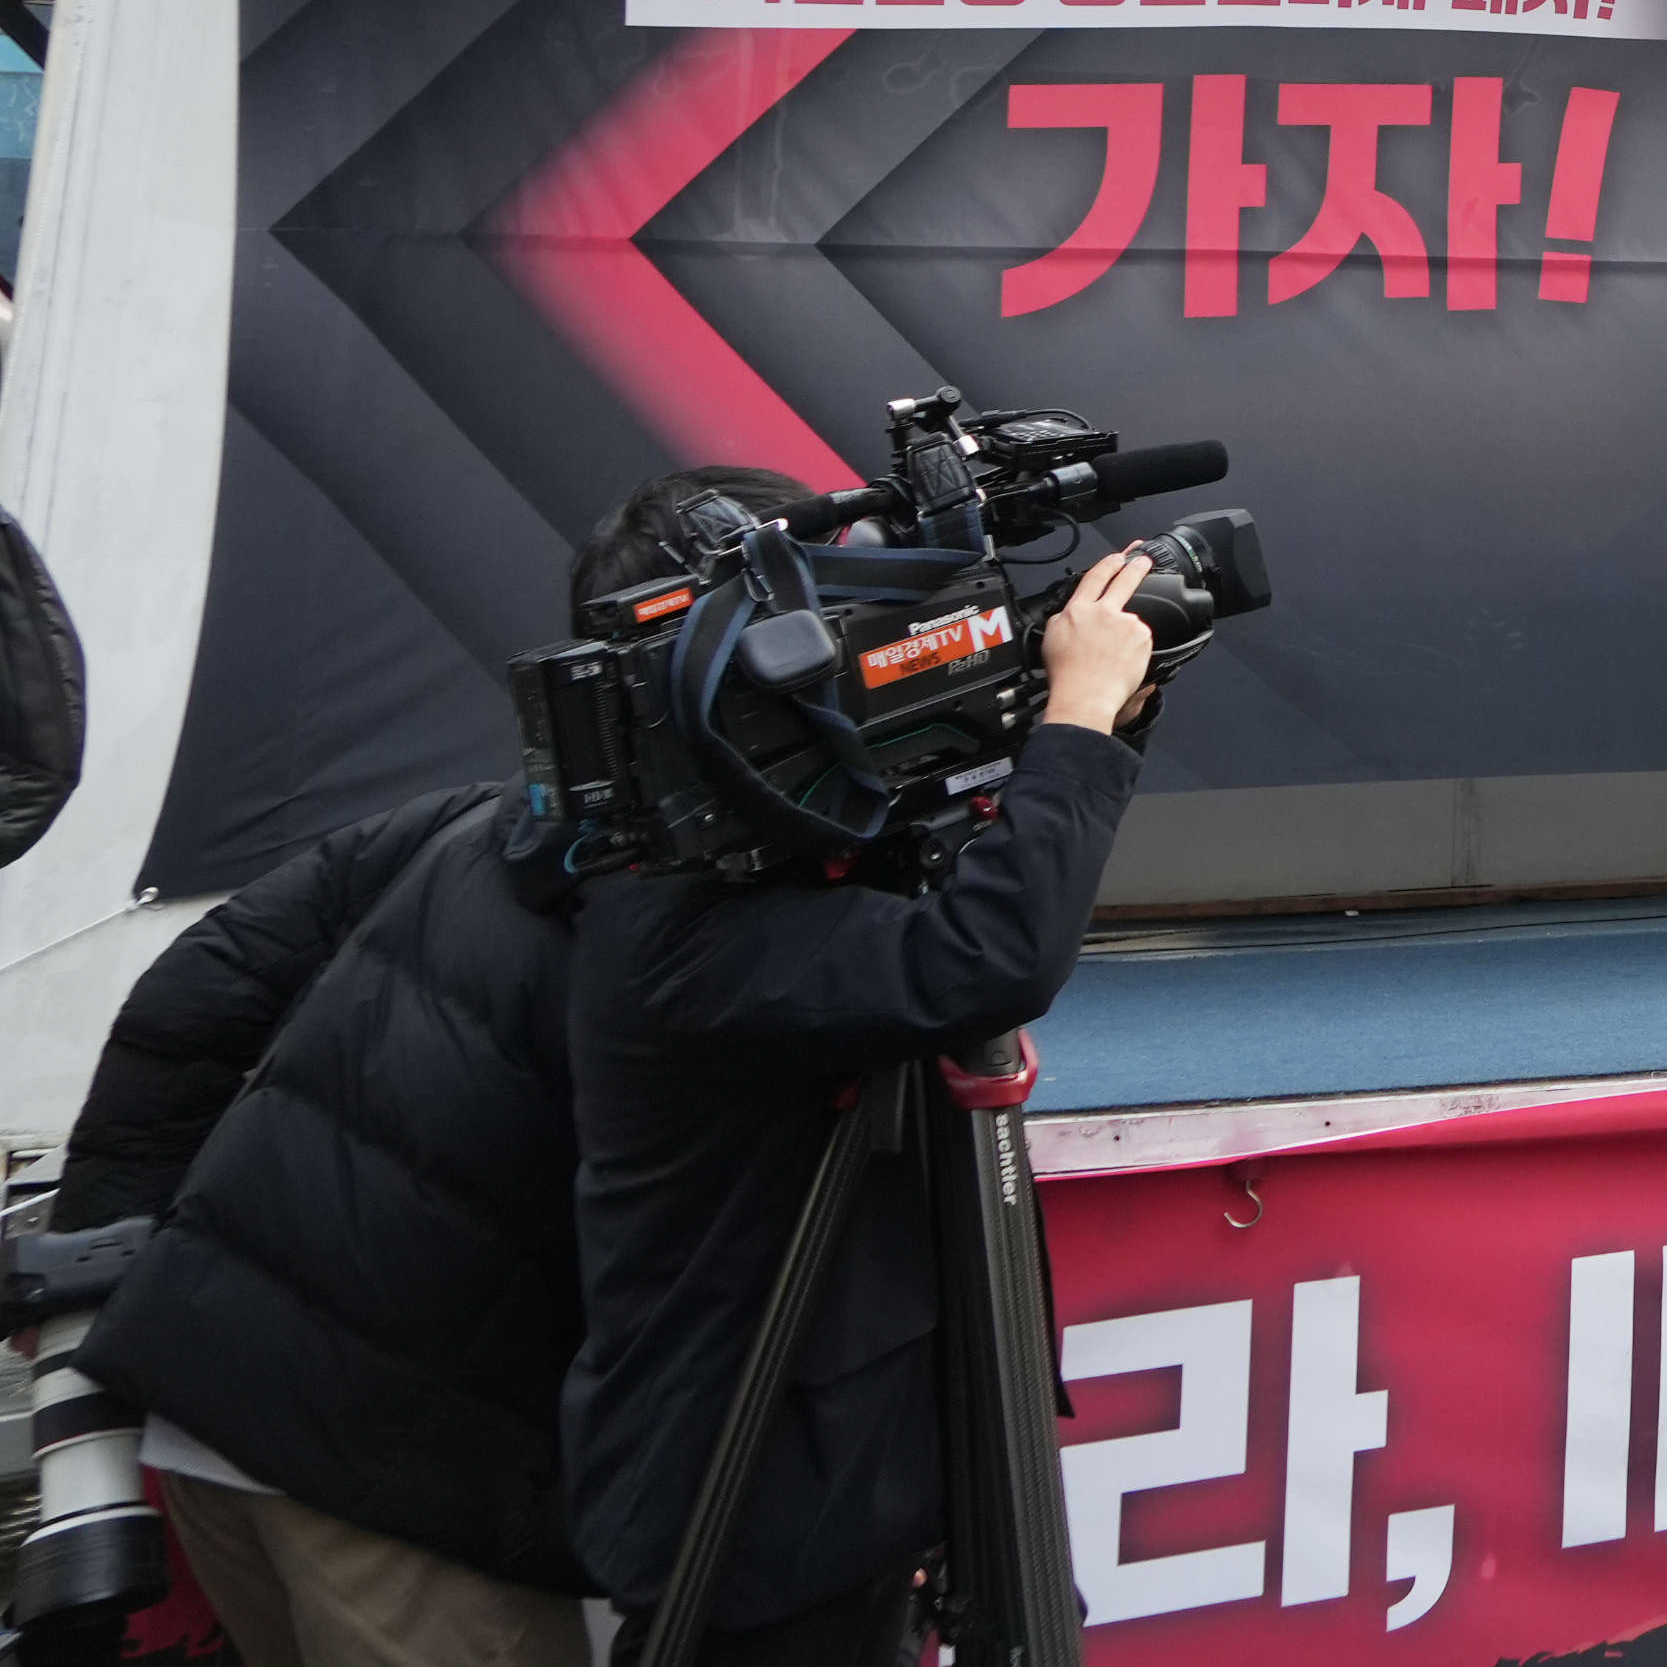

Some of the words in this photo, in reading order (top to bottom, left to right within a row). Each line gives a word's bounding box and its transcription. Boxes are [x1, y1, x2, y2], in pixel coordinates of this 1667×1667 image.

[1000, 73, 1620, 318] 가자!
[867, 625, 963, 668] 매일경제TV
[908, 605, 980, 635] Panasonic
[994, 1113, 1018, 1206] sachtler
